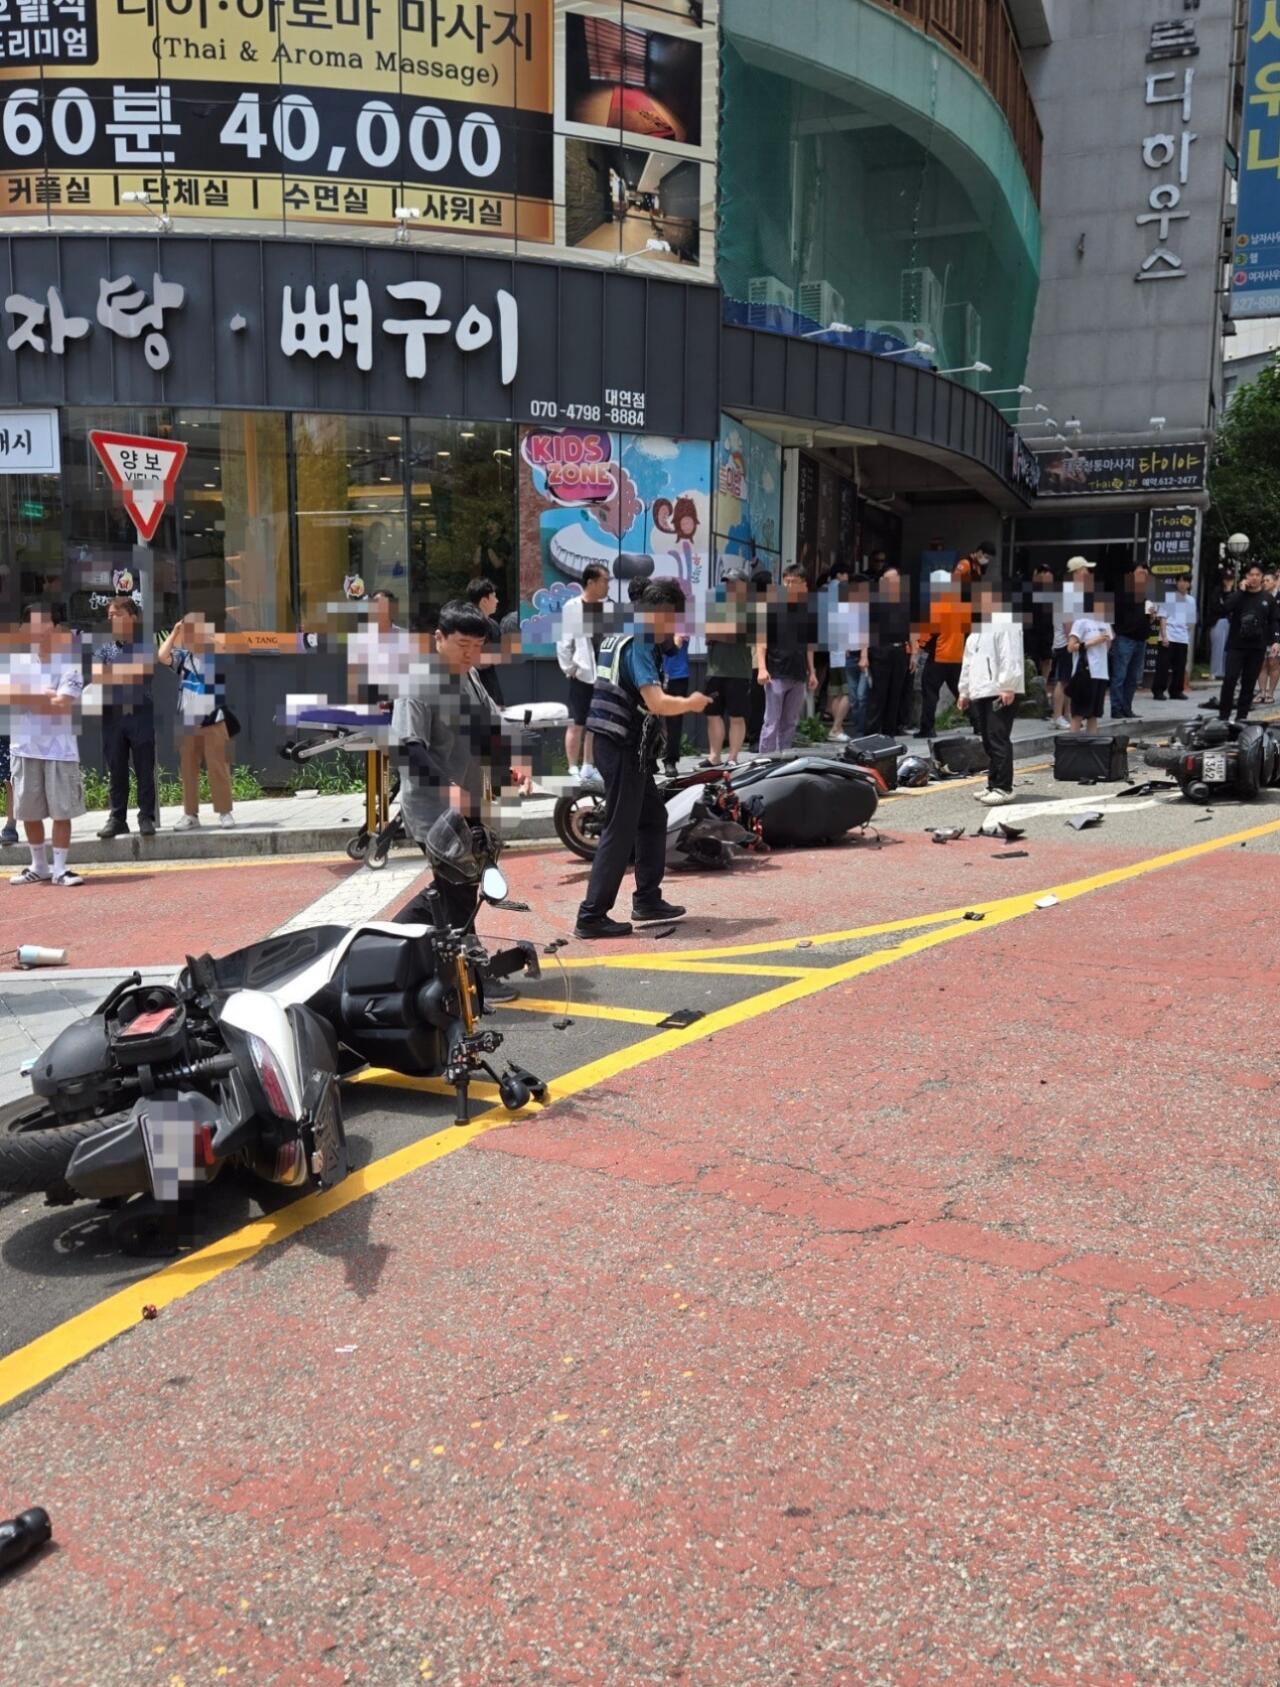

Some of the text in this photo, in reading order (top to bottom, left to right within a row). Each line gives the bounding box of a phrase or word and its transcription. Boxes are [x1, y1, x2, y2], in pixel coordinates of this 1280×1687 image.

[0, 27, 88, 58] 리미엄
[402, 0, 532, 61] 마사지
[152, 36, 500, 86] (Thai & Aroma Massage)
[2, 85, 501, 178] 60분 40,000
[8, 177, 503, 226] 커플실 단체실 수면실 샤워실
[281, 279, 518, 385] 뼈구이
[605, 389, 645, 409] 대연점
[531, 435, 605, 464] KIDS
[546, 462, 612, 485] ZONE
[1153, 540, 1191, 554] 이벤트
